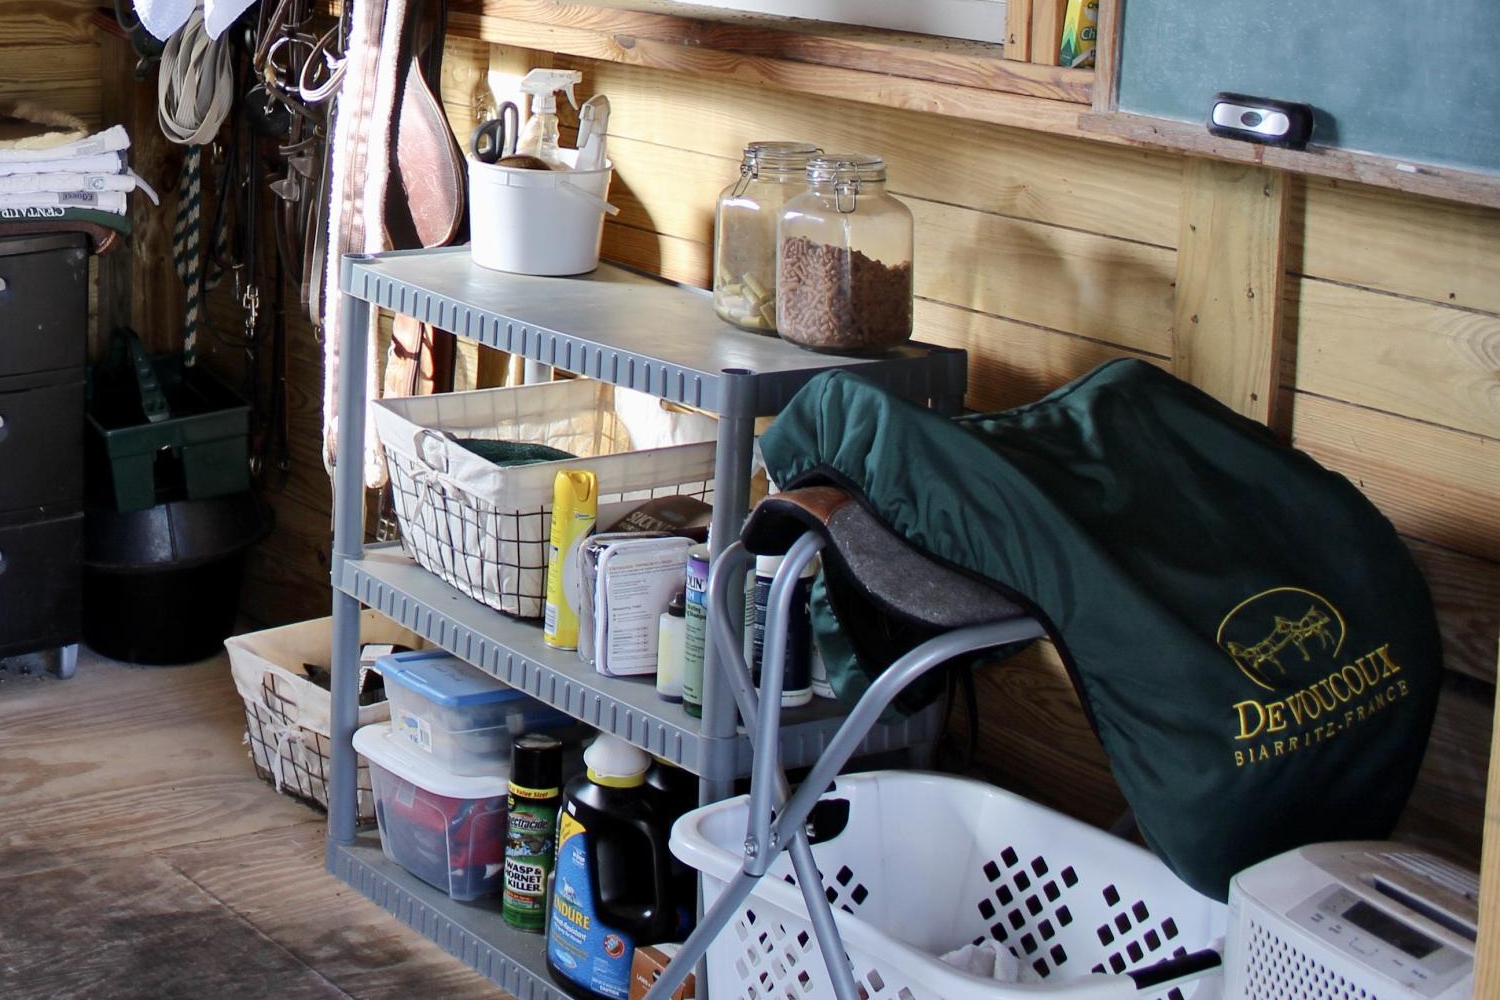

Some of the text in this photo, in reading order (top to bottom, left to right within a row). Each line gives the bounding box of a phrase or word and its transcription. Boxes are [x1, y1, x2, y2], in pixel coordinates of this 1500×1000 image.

[1232, 643, 1400, 740] DEVOUCOUX
[506, 860, 542, 875] WASP &
[508, 878, 540, 891] KILLER
